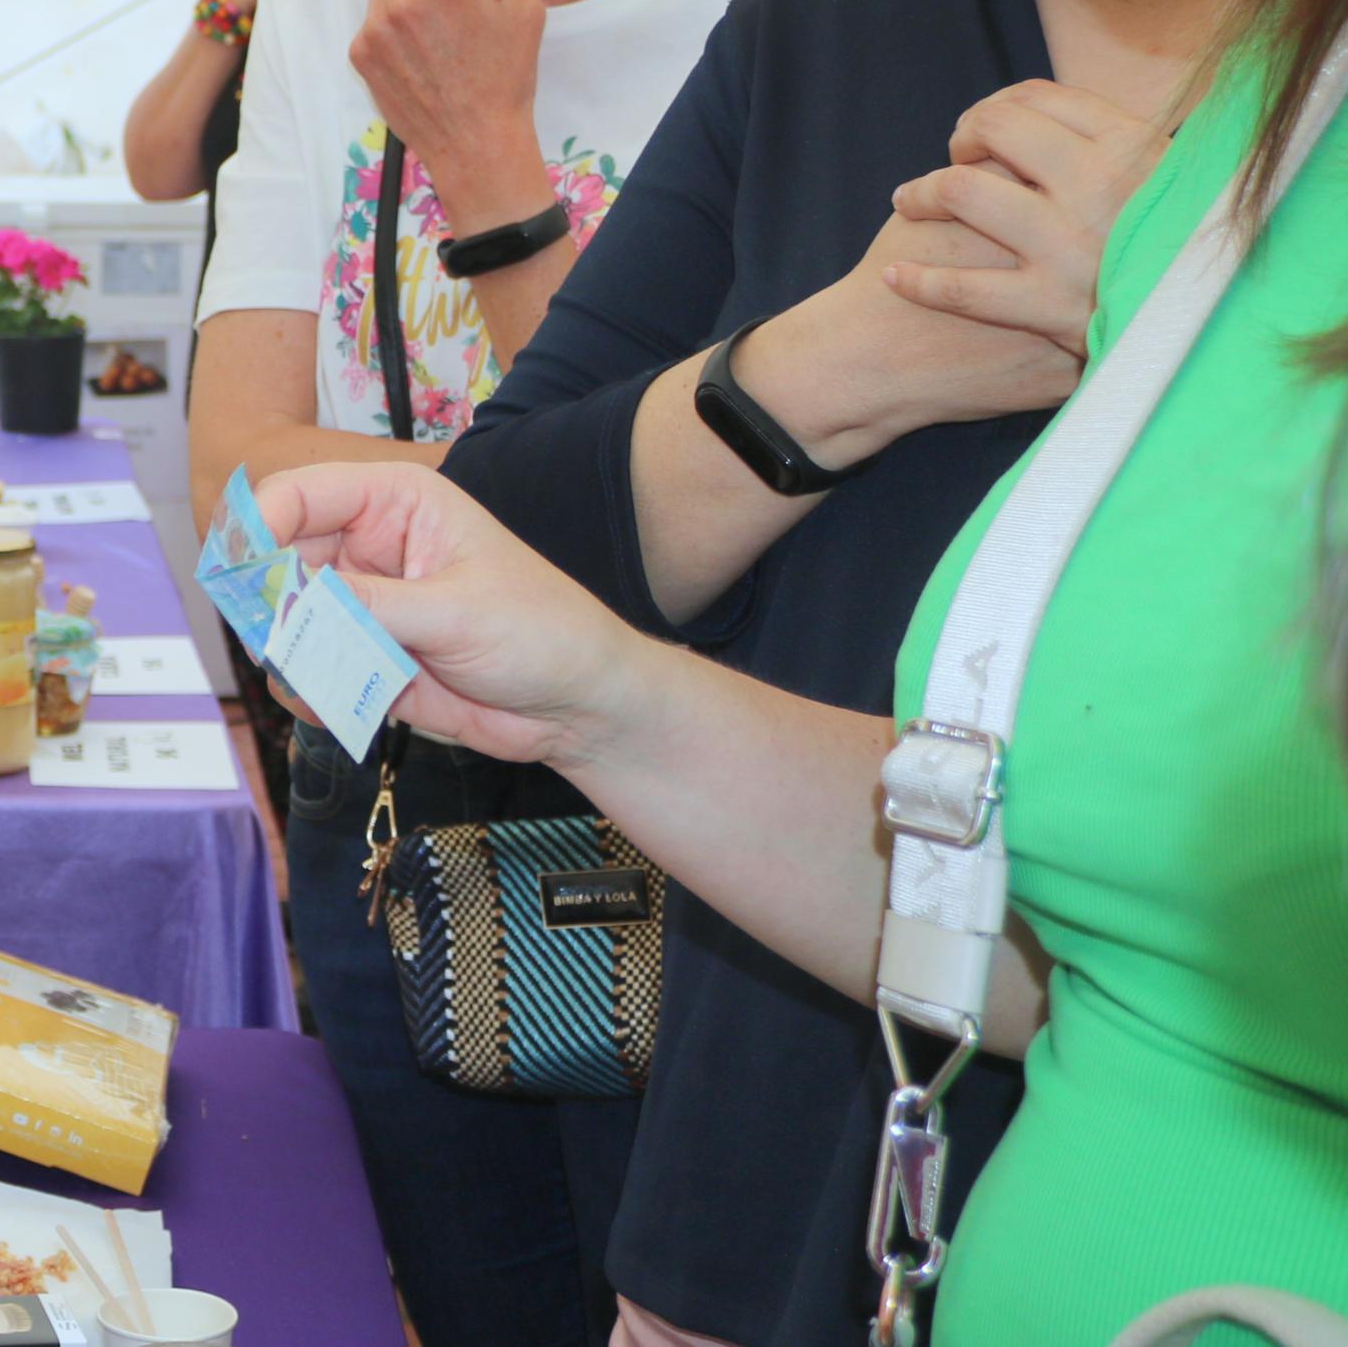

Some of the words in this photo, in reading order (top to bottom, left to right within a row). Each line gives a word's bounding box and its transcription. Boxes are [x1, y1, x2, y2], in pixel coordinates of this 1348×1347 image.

[352, 670, 380, 717] EURO
[593, 893, 602, 903] Y
[605, 891, 637, 903] LOLA
